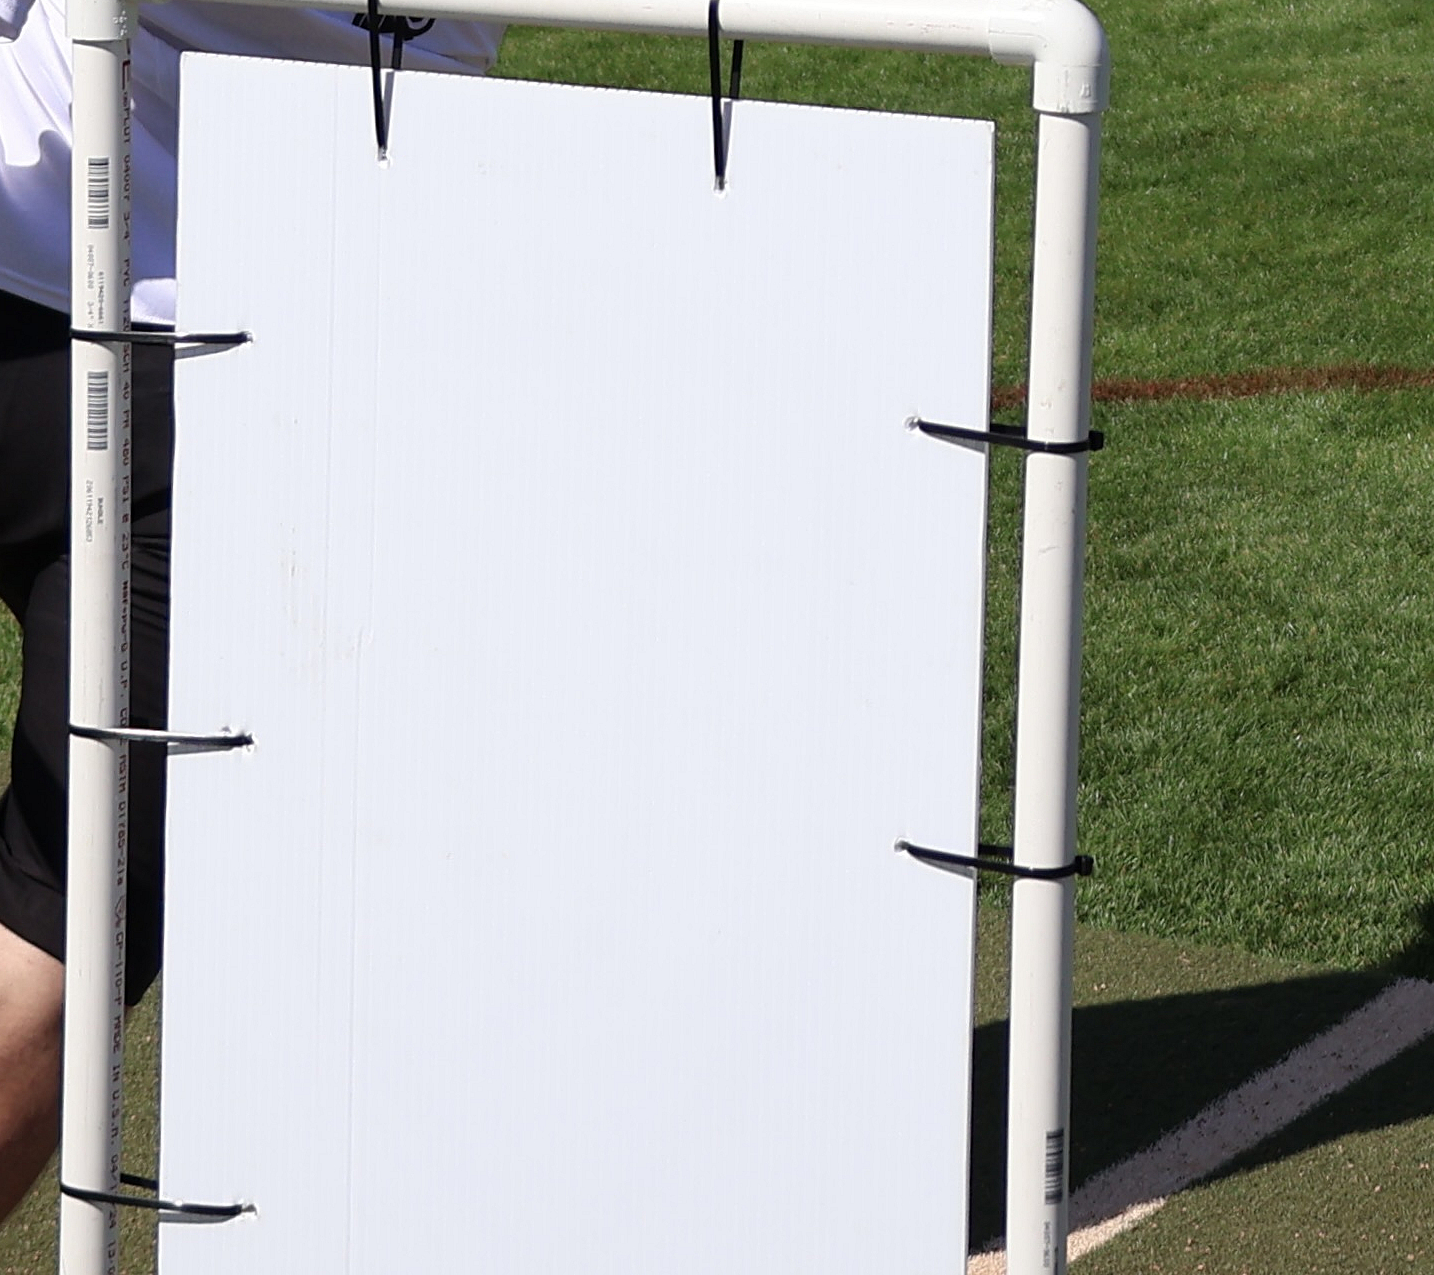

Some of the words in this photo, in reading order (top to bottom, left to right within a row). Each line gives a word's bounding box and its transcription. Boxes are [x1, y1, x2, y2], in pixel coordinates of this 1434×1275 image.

[122, 258, 130, 287] PVC
[122, 344, 130, 374] SCH
[122, 382, 130, 401] 40
[117, 754, 127, 794] ASTM
[112, 1015, 122, 1054] MADE
[111, 1065, 121, 1083] IN
